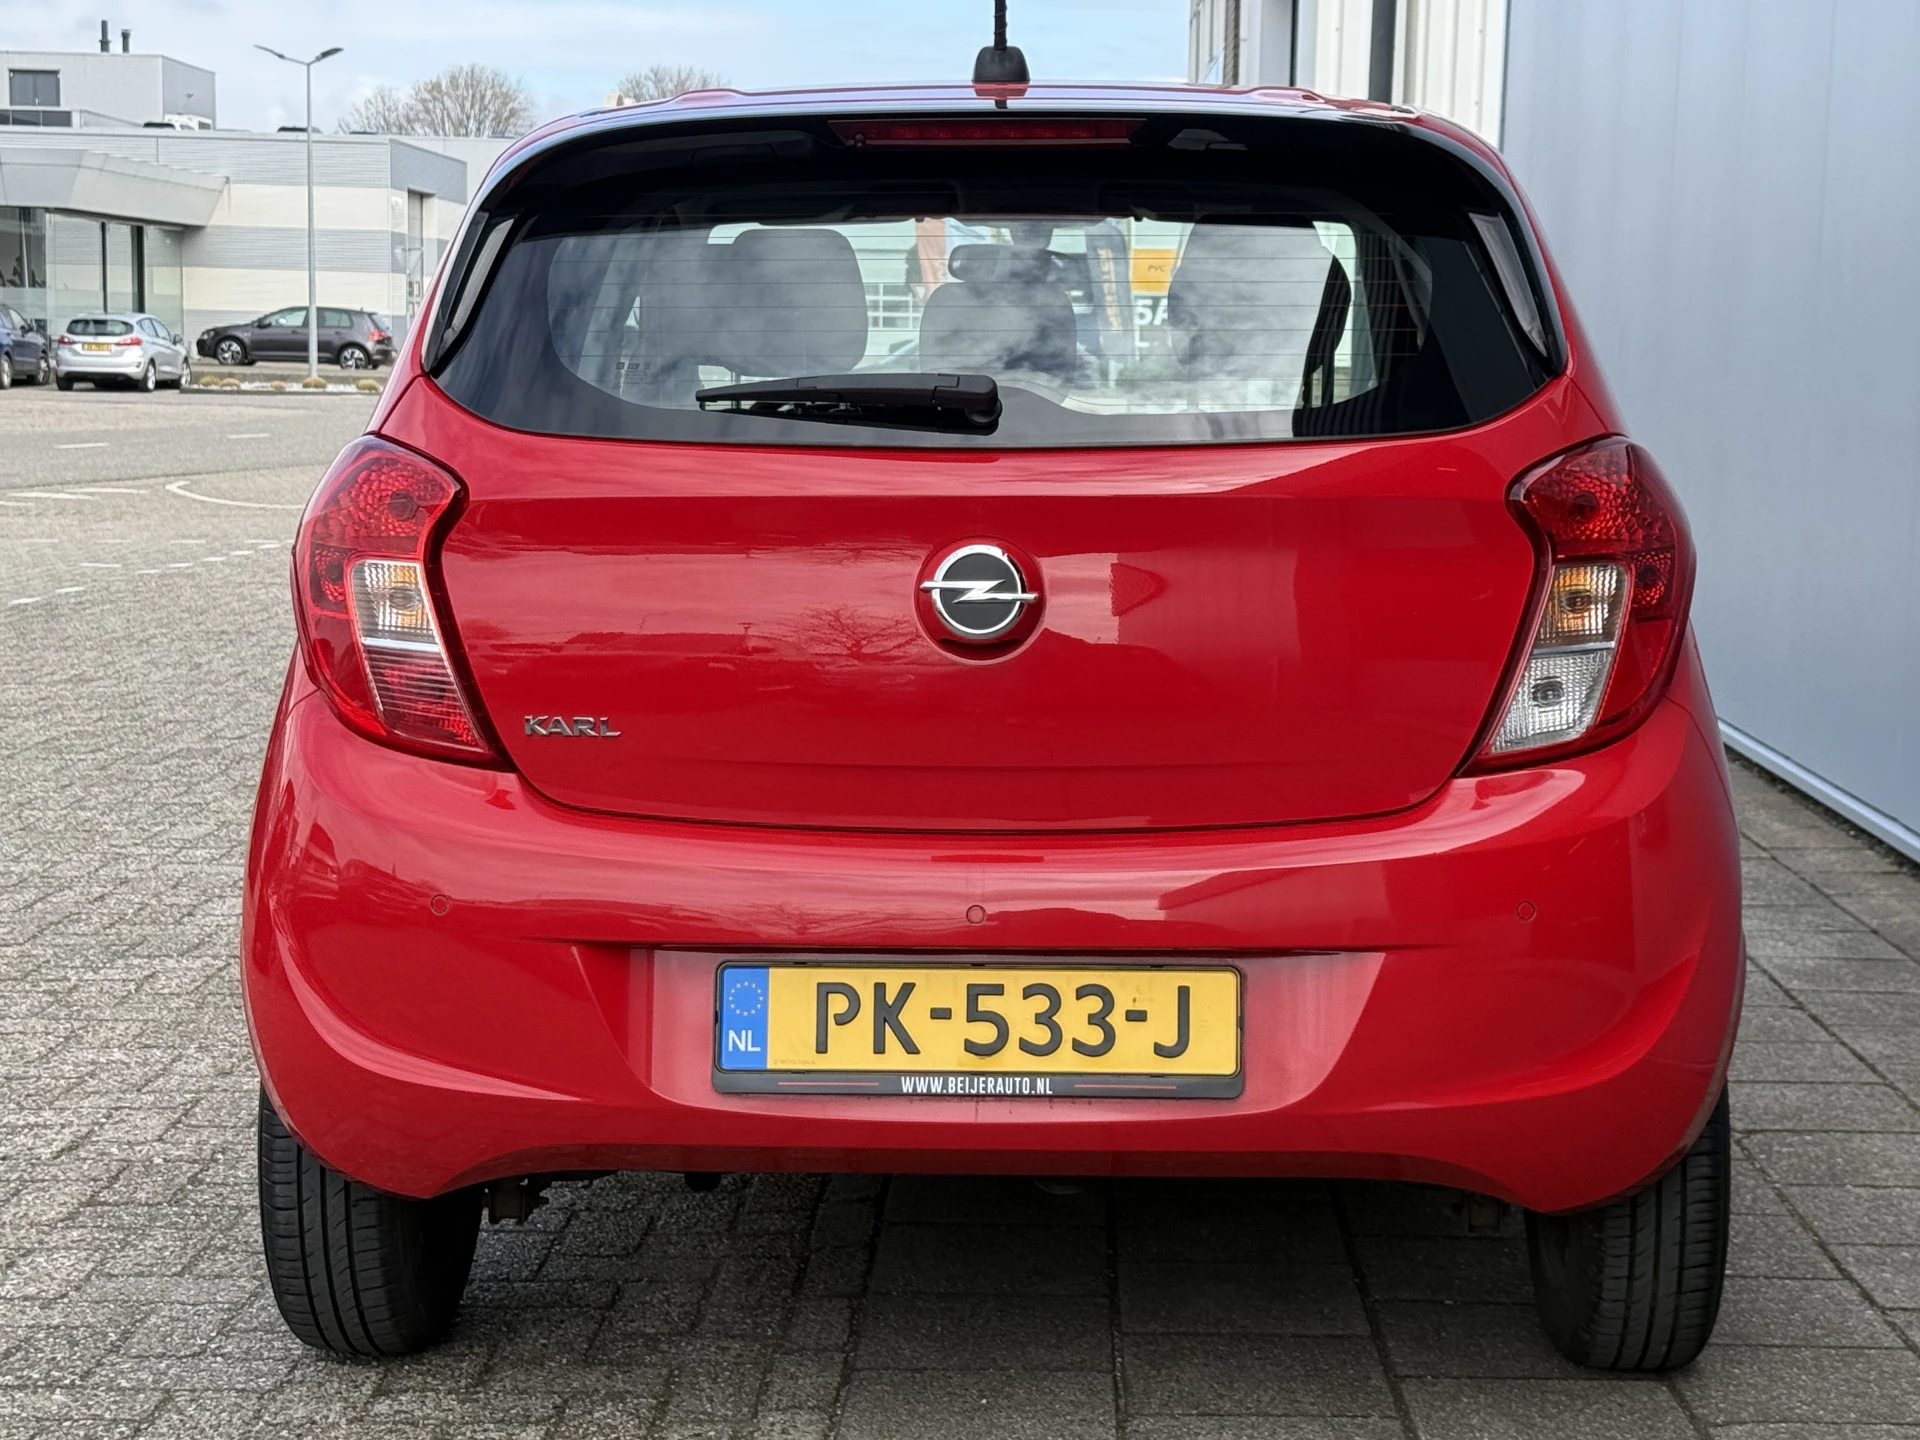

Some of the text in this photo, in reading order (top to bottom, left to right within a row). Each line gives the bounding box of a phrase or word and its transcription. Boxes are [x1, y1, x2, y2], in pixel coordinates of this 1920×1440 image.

[524, 715, 622, 737] KARL
[815, 982, 1191, 1059] PK-533-J
[728, 1029, 762, 1053] NL
[901, 1076, 1053, 1094] WWW.BEIJERAUTO.NL
